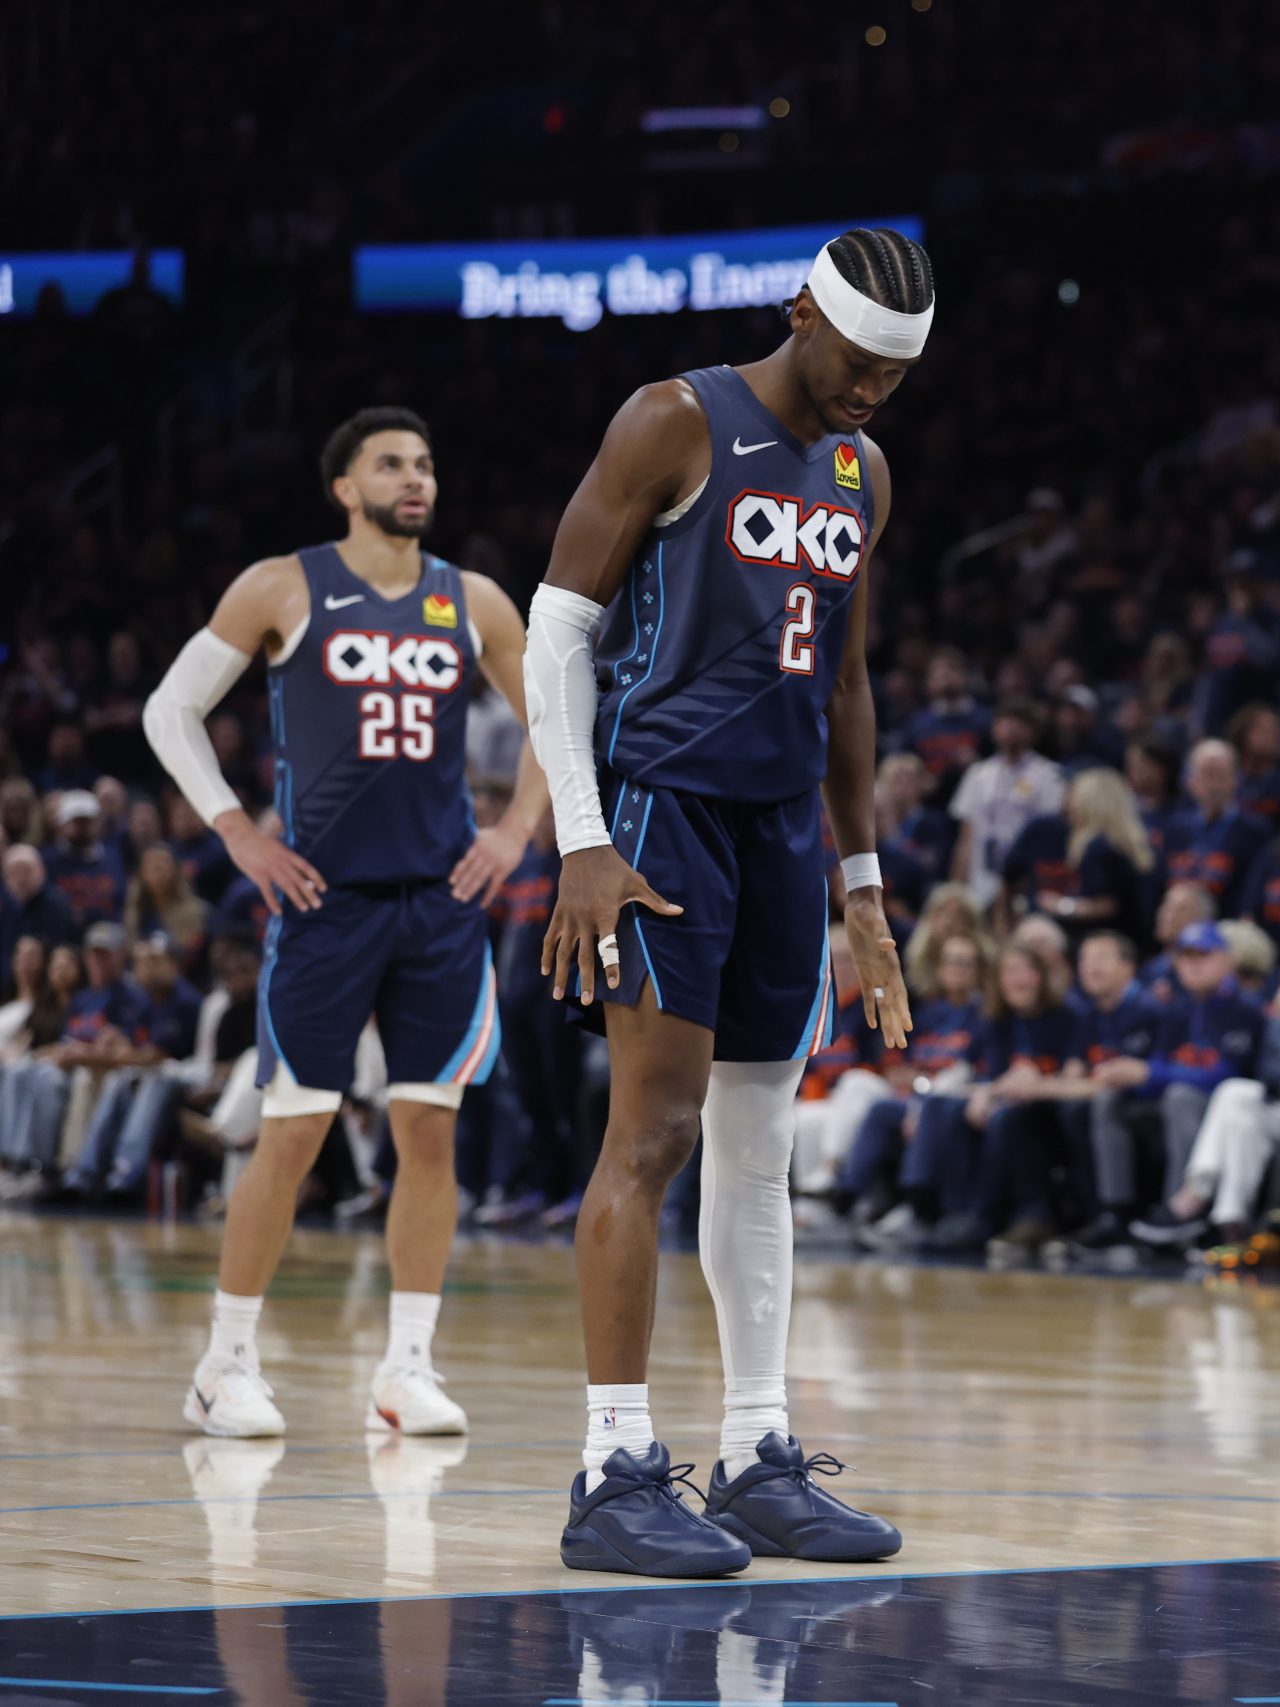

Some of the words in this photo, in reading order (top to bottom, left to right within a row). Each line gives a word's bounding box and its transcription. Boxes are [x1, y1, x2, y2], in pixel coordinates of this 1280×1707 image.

[606, 254, 688, 315] the
[728, 491, 864, 580] OKC
[325, 631, 462, 692] OKC
[780, 583, 816, 674] 2
[359, 690, 436, 762] 25
